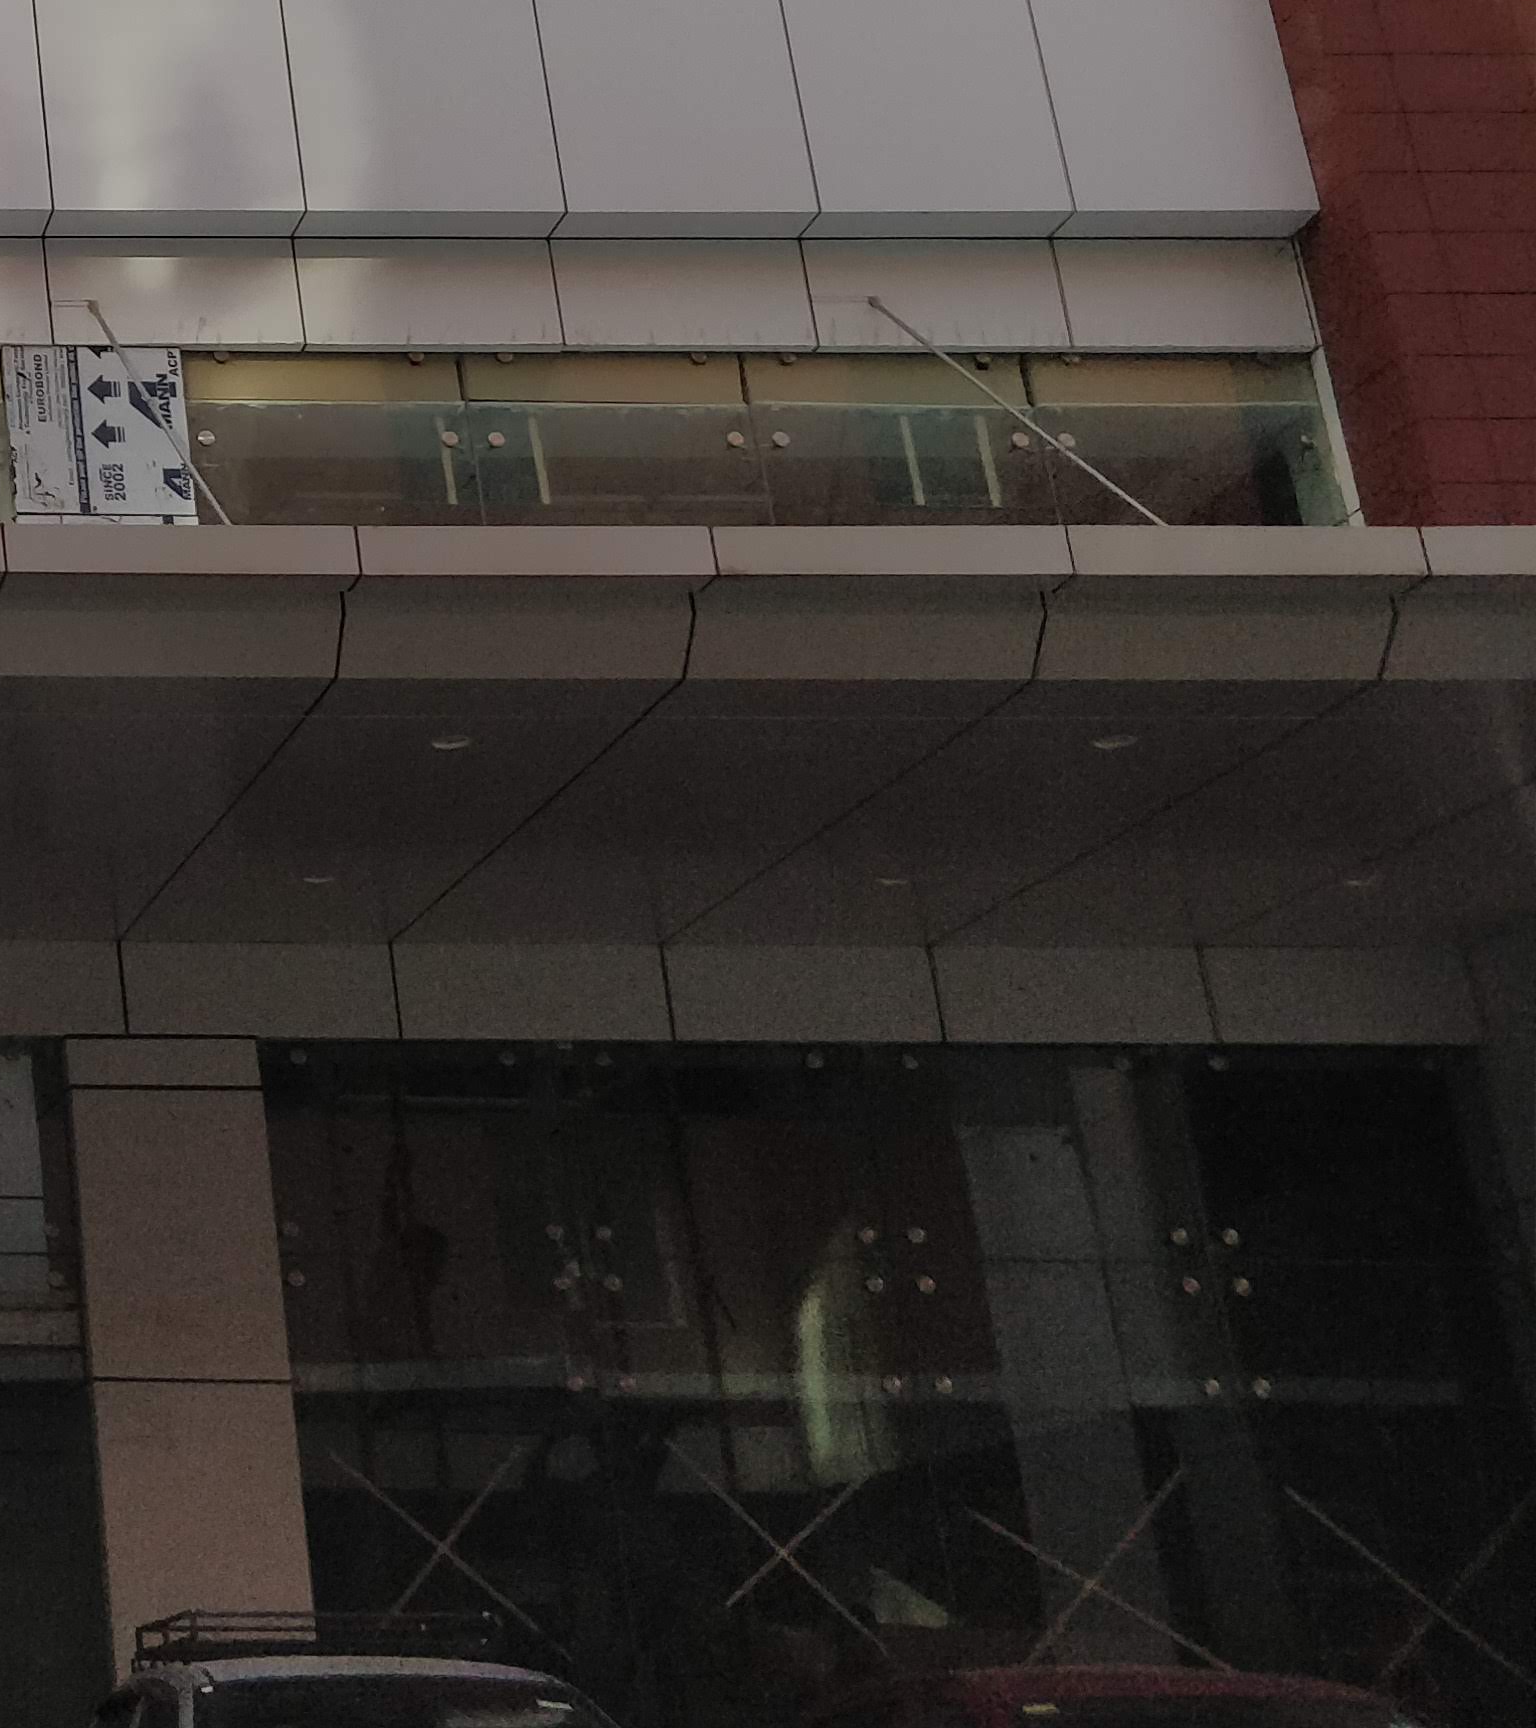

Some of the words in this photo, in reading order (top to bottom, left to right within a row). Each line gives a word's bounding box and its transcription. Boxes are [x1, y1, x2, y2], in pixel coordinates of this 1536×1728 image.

[167, 351, 179, 377] ACP
[33, 353, 47, 422] EUROBOND
[102, 463, 115, 501] SINCE
[113, 463, 126, 501] 2002
